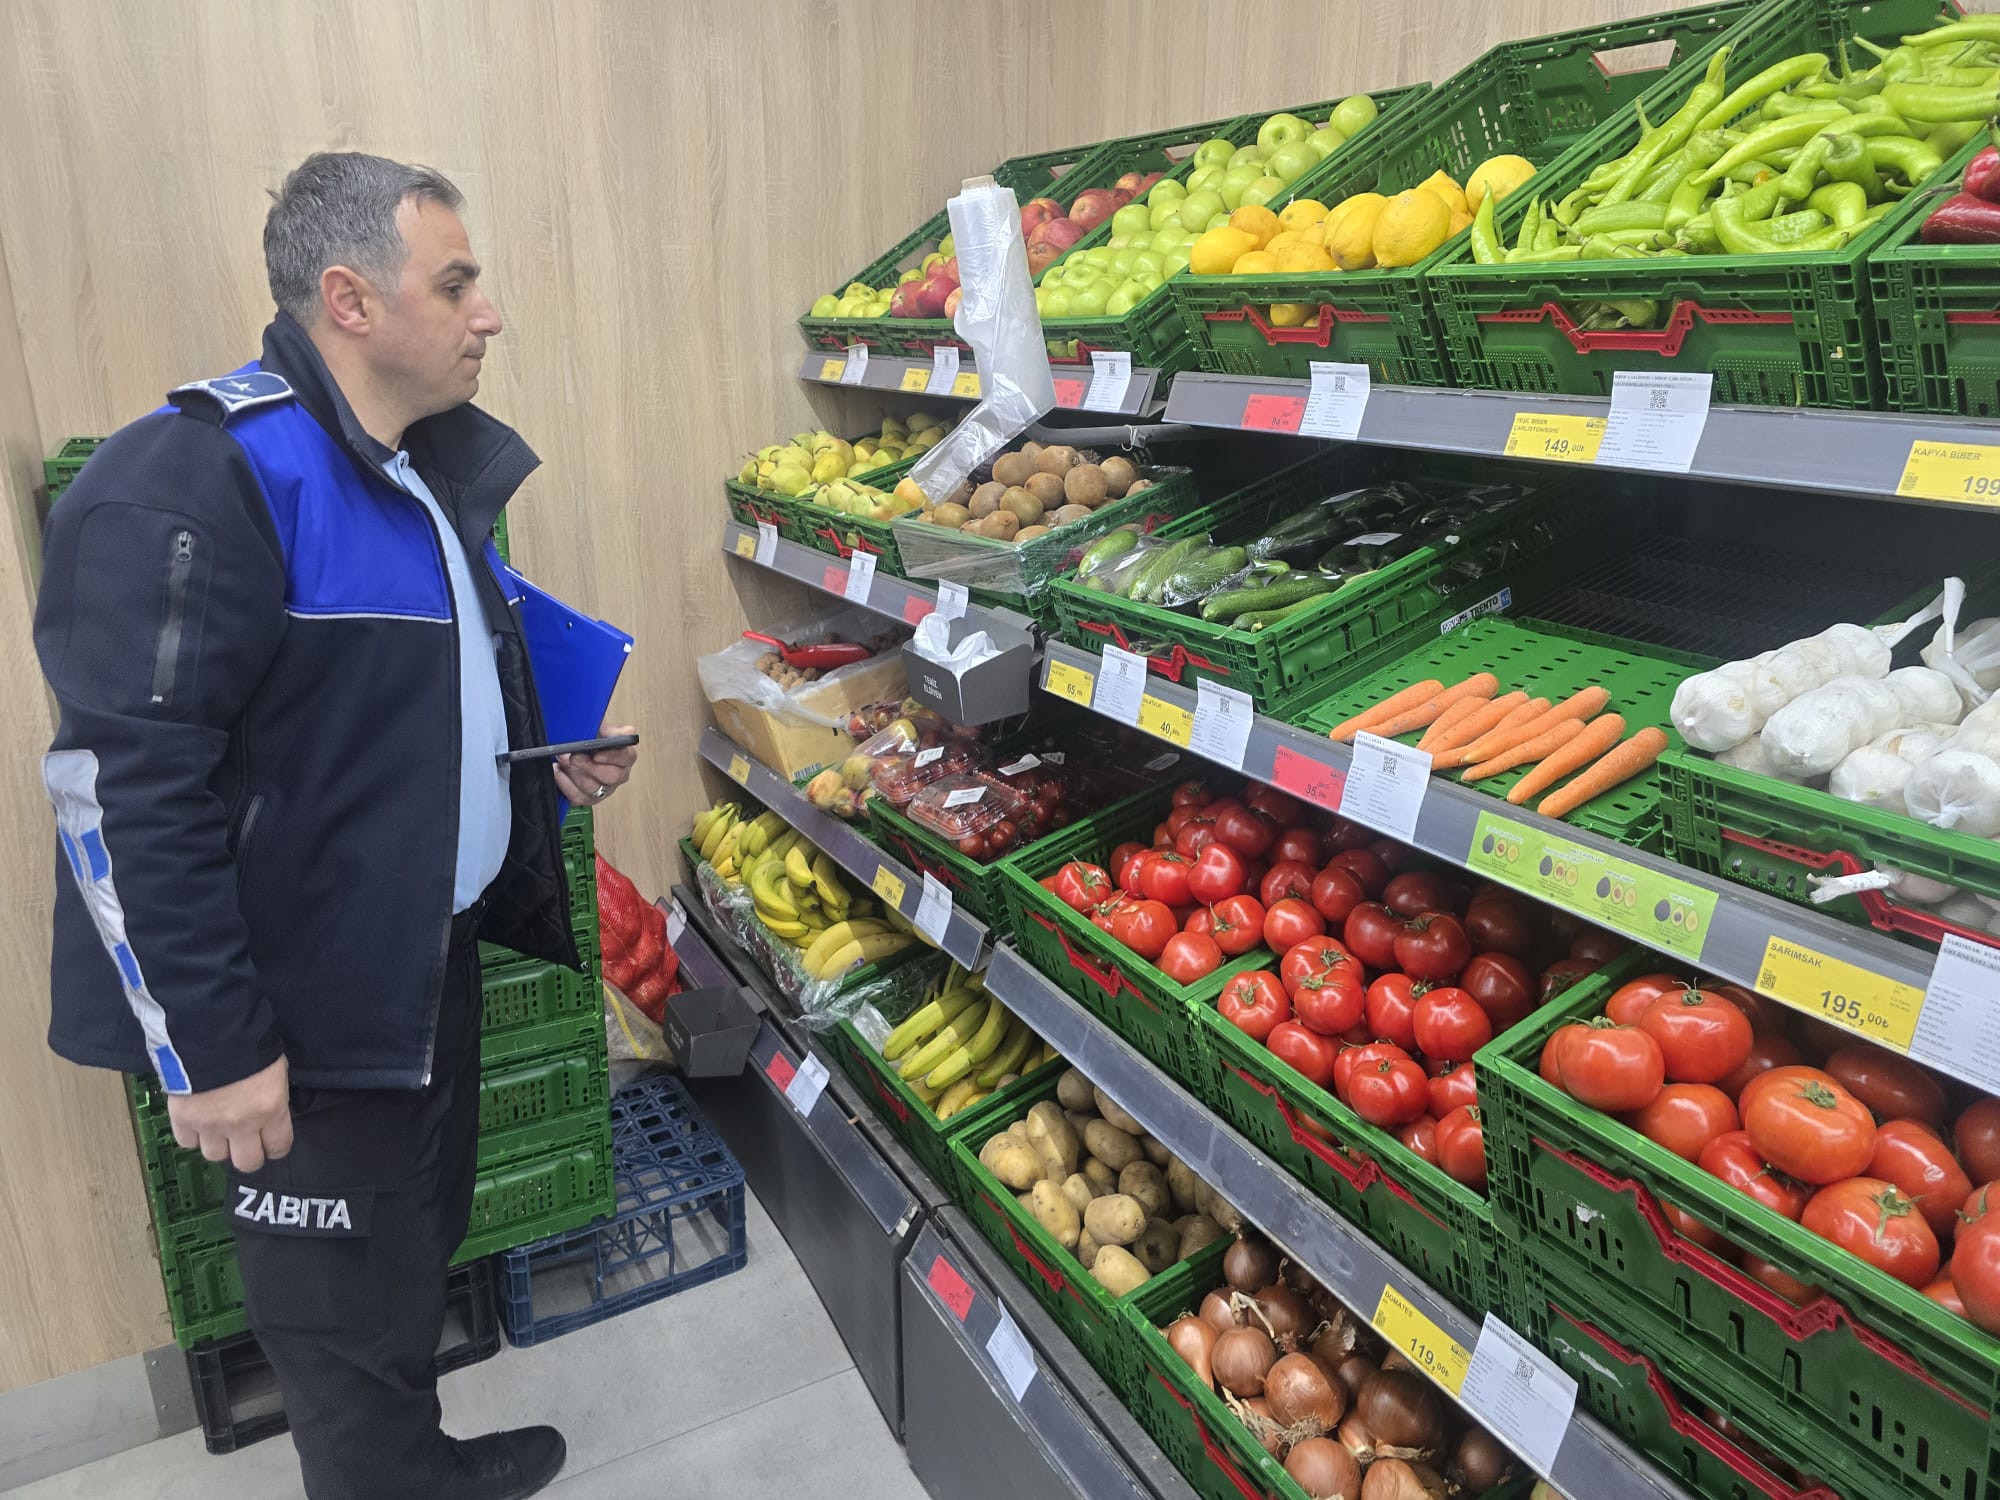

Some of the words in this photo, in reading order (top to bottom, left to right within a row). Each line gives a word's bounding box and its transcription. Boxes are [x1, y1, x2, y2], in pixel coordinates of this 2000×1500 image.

[1912, 447, 1947, 459] KAPYA
[1949, 450, 1982, 461] BİBER
[1770, 942, 1823, 968] SARIMSAK
[234, 1184, 352, 1230] ZABITA
[1384, 1290, 1413, 1318] DOMATES
